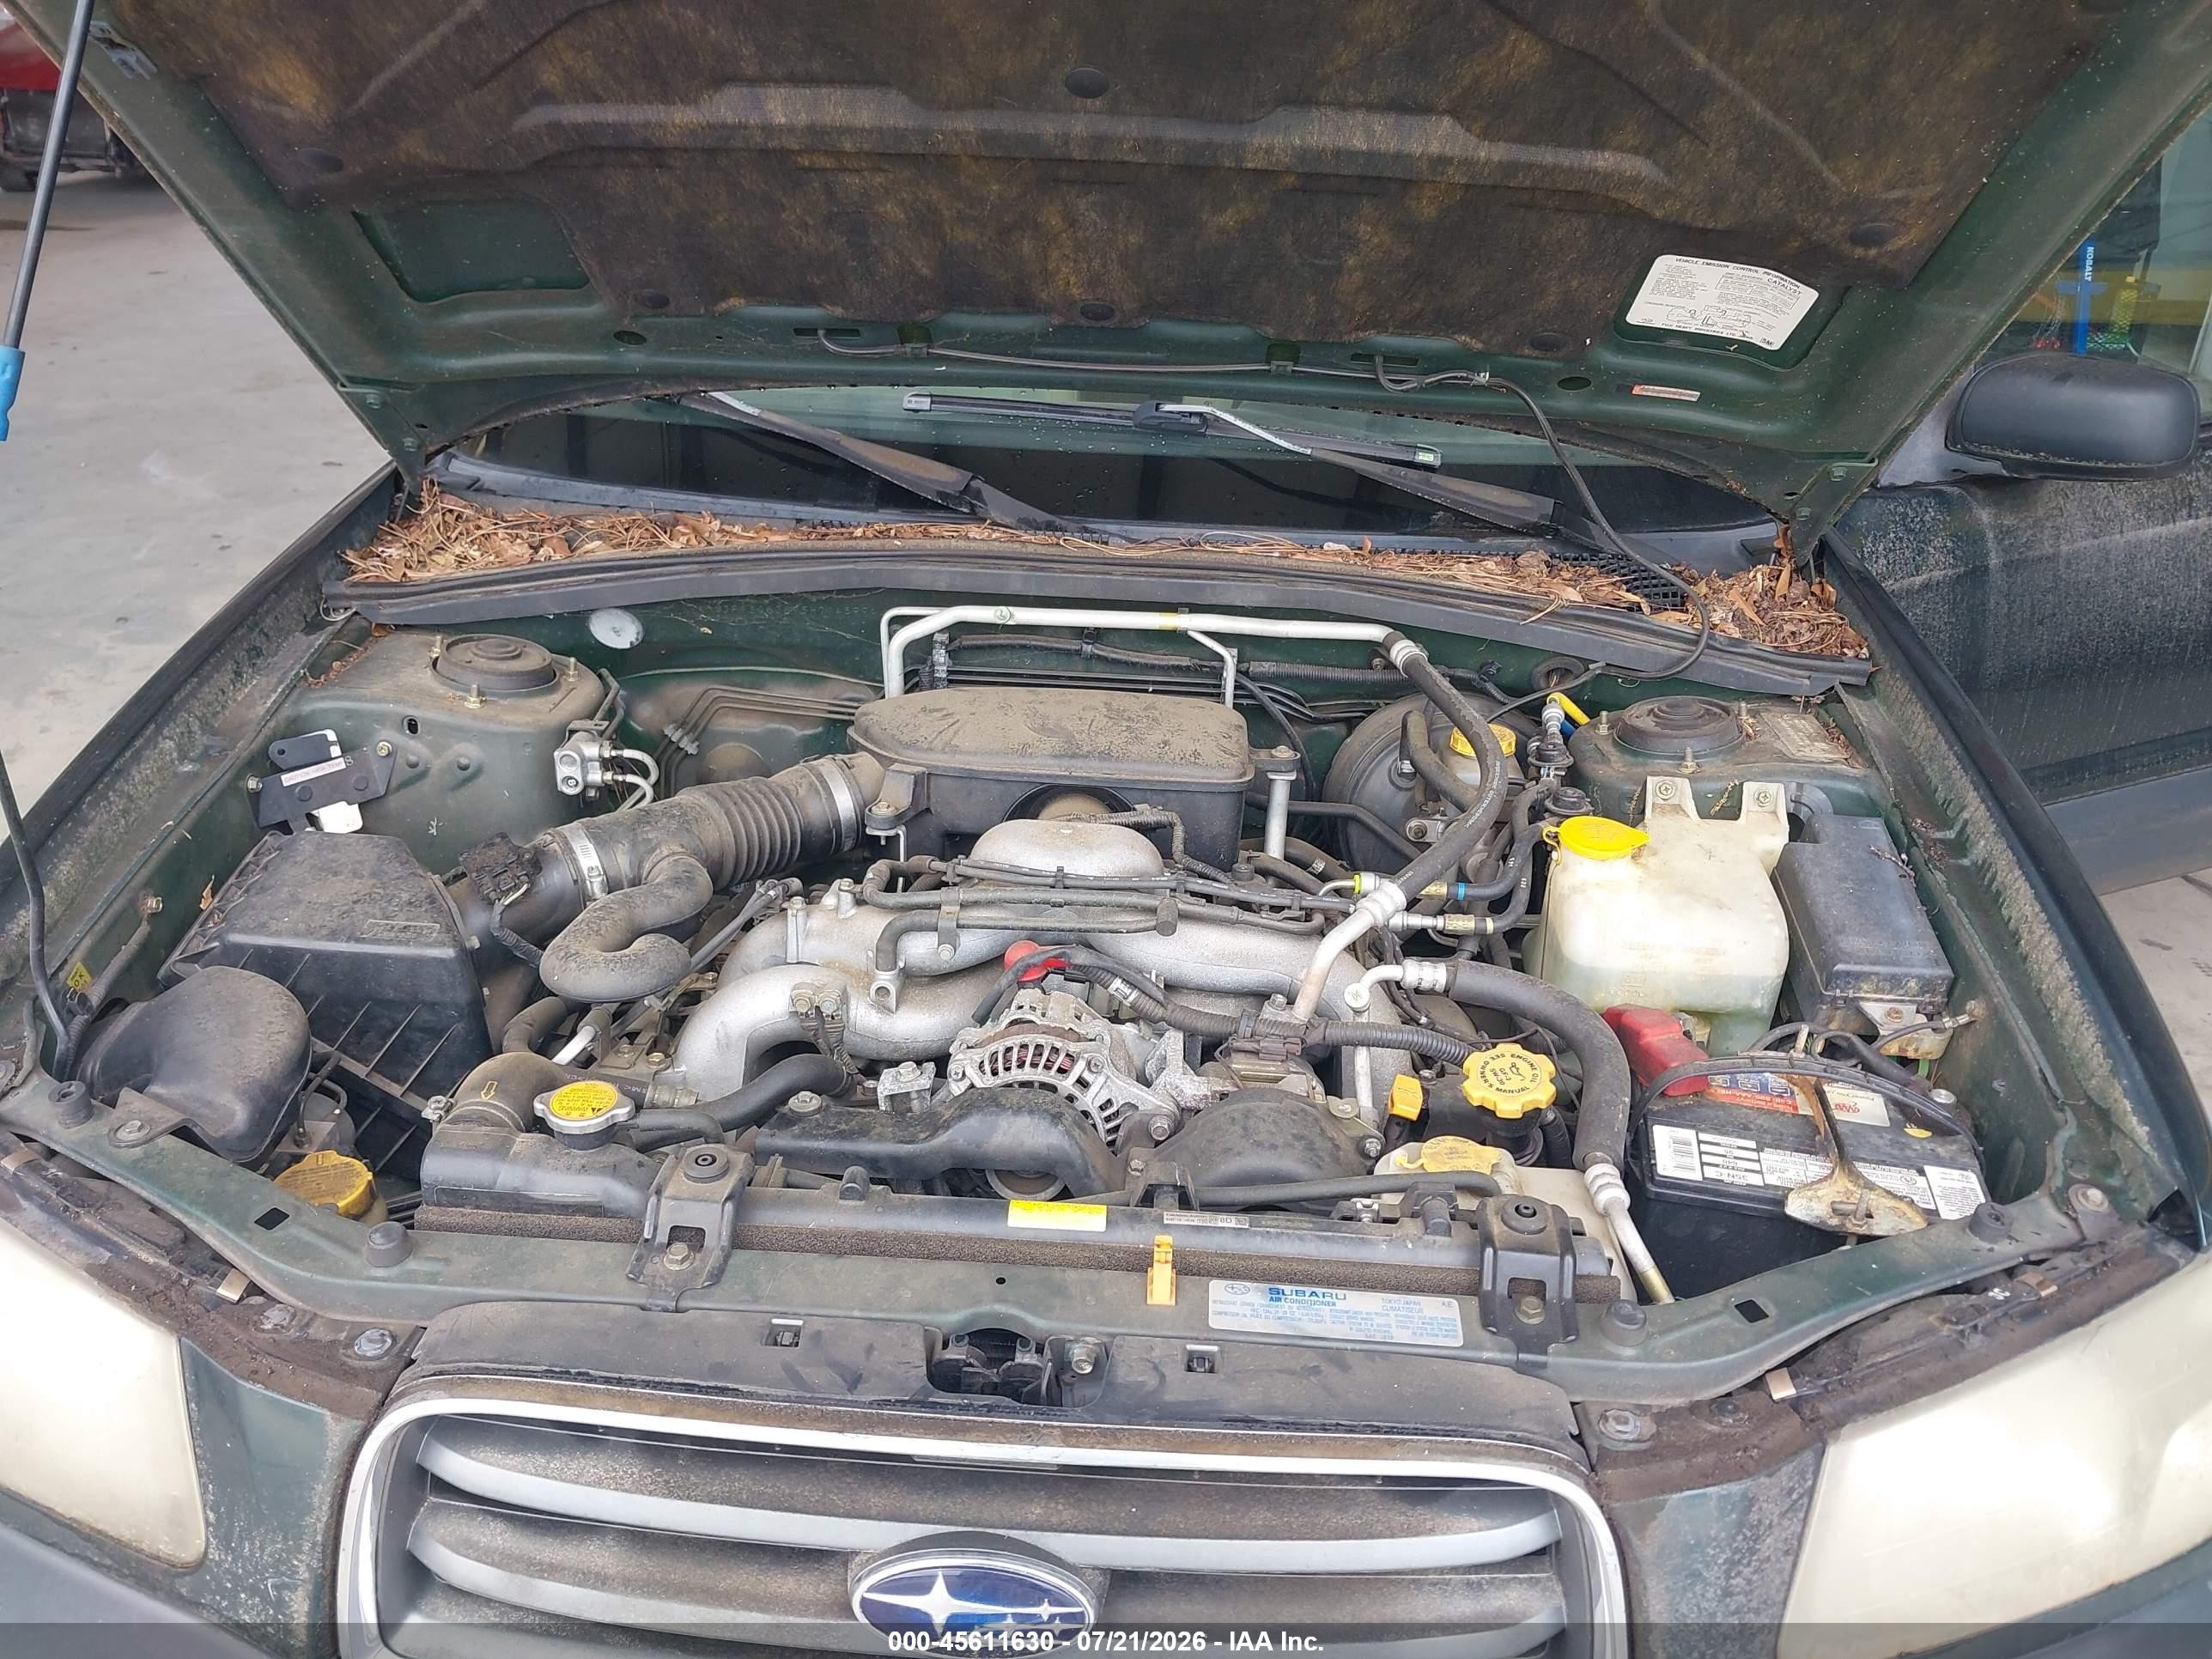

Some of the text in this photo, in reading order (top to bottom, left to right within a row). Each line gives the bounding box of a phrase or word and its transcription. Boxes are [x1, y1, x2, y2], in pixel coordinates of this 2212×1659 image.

[2084, 246, 2095, 283] KOBALT
[1675, 257, 1801, 289] VEHICLE EMISSION CONTROL INFORMATION
[1766, 277, 1802, 296] CATALYST
[1693, 326, 1724, 336] INDUSTRIES
[1489, 1053, 1506, 1061] SEE
[1488, 1067, 1505, 1085] 5W-30
[1510, 1053, 1540, 1084] ENGINE OIL
[1494, 1085, 1531, 1095] MANUAL
[1267, 1286, 1347, 1301] SUBARU
[1268, 1296, 1282, 1304] AIR
[1283, 1297, 1337, 1308] CONDITIONER
[1381, 1305, 1425, 1315] CLIMATISEUR
